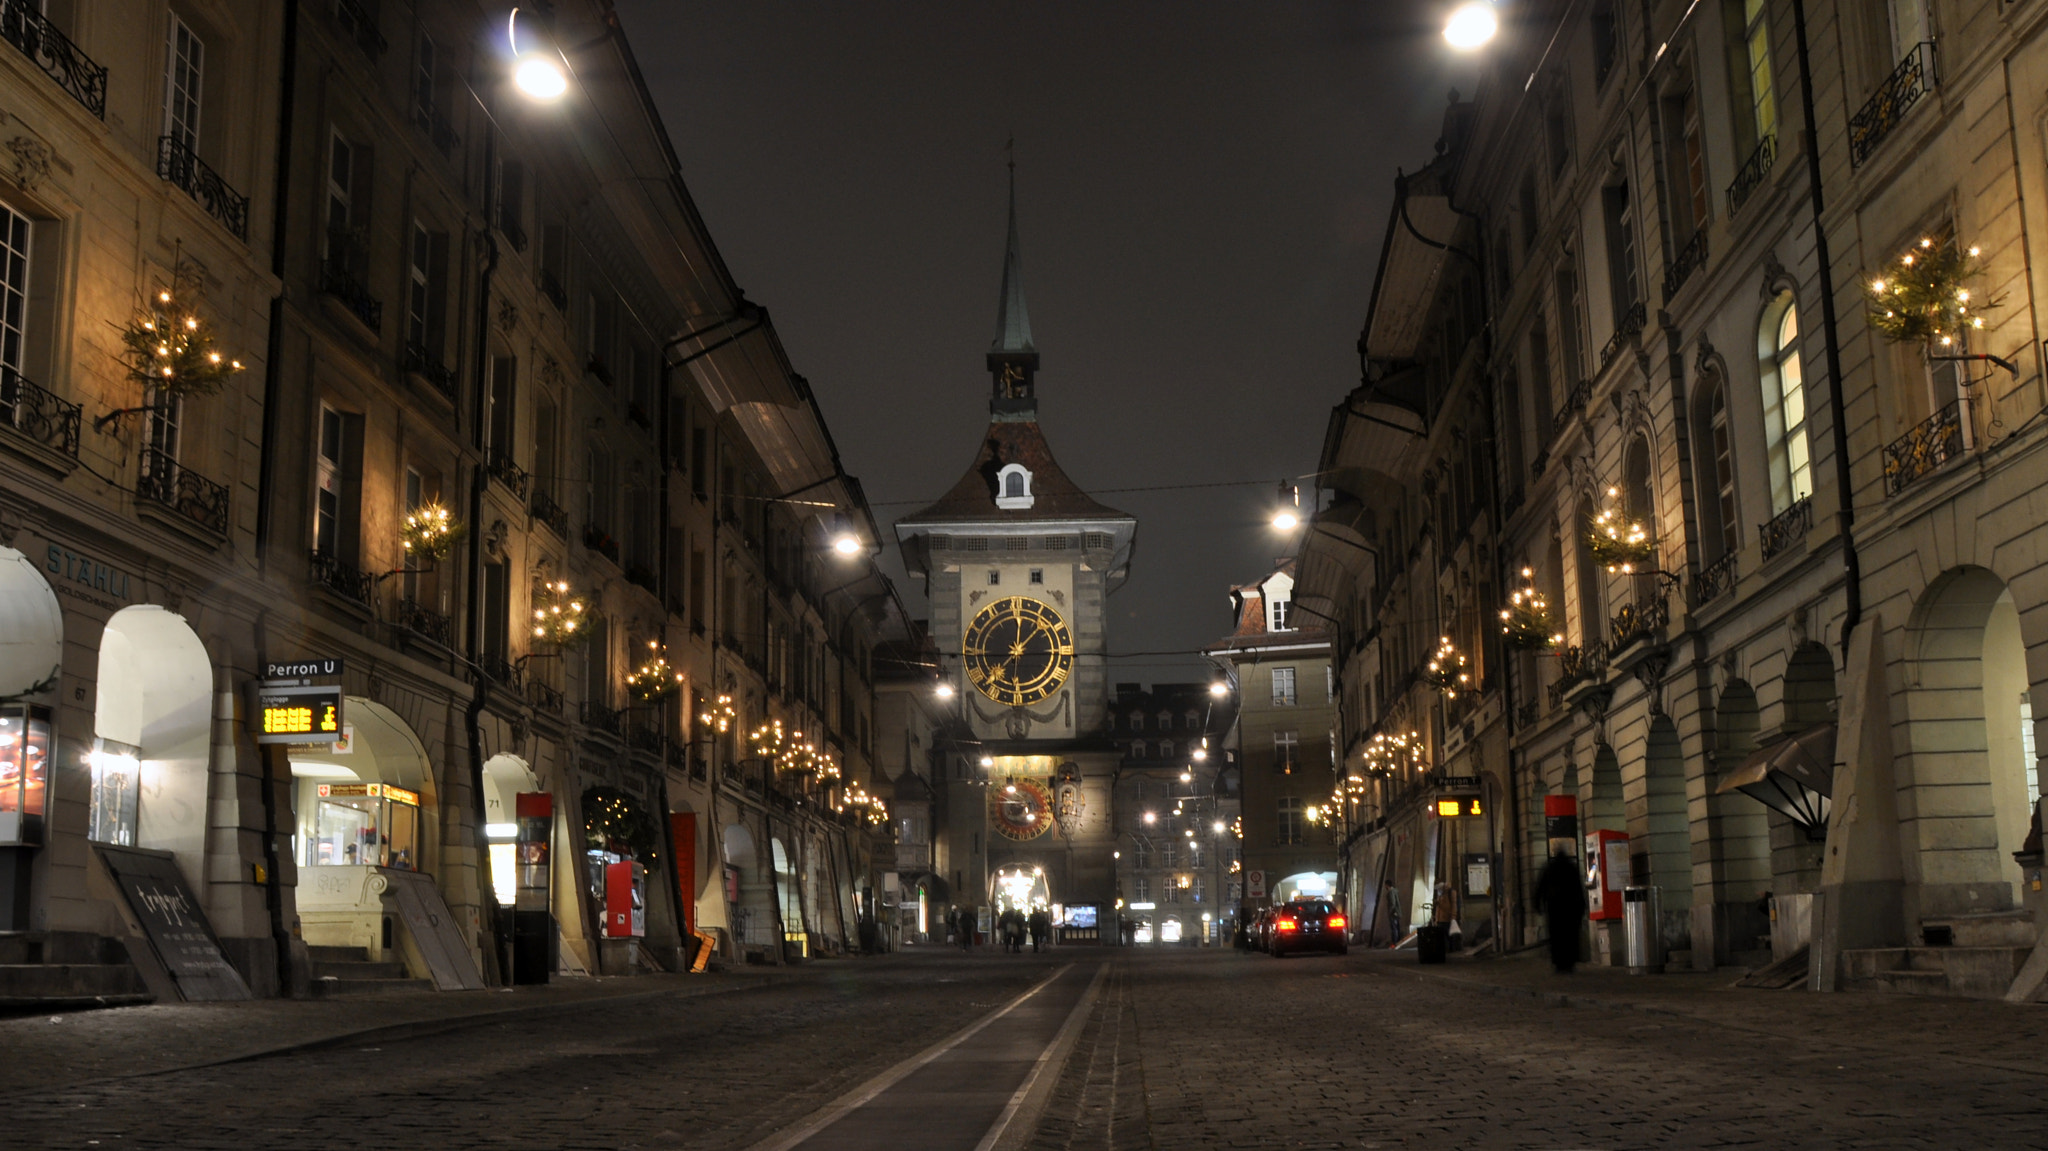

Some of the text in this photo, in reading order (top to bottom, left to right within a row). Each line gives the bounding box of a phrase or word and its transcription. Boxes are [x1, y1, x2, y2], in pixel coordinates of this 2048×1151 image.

[268, 660, 334, 676] Perron U
[489, 800, 499, 808] 71
